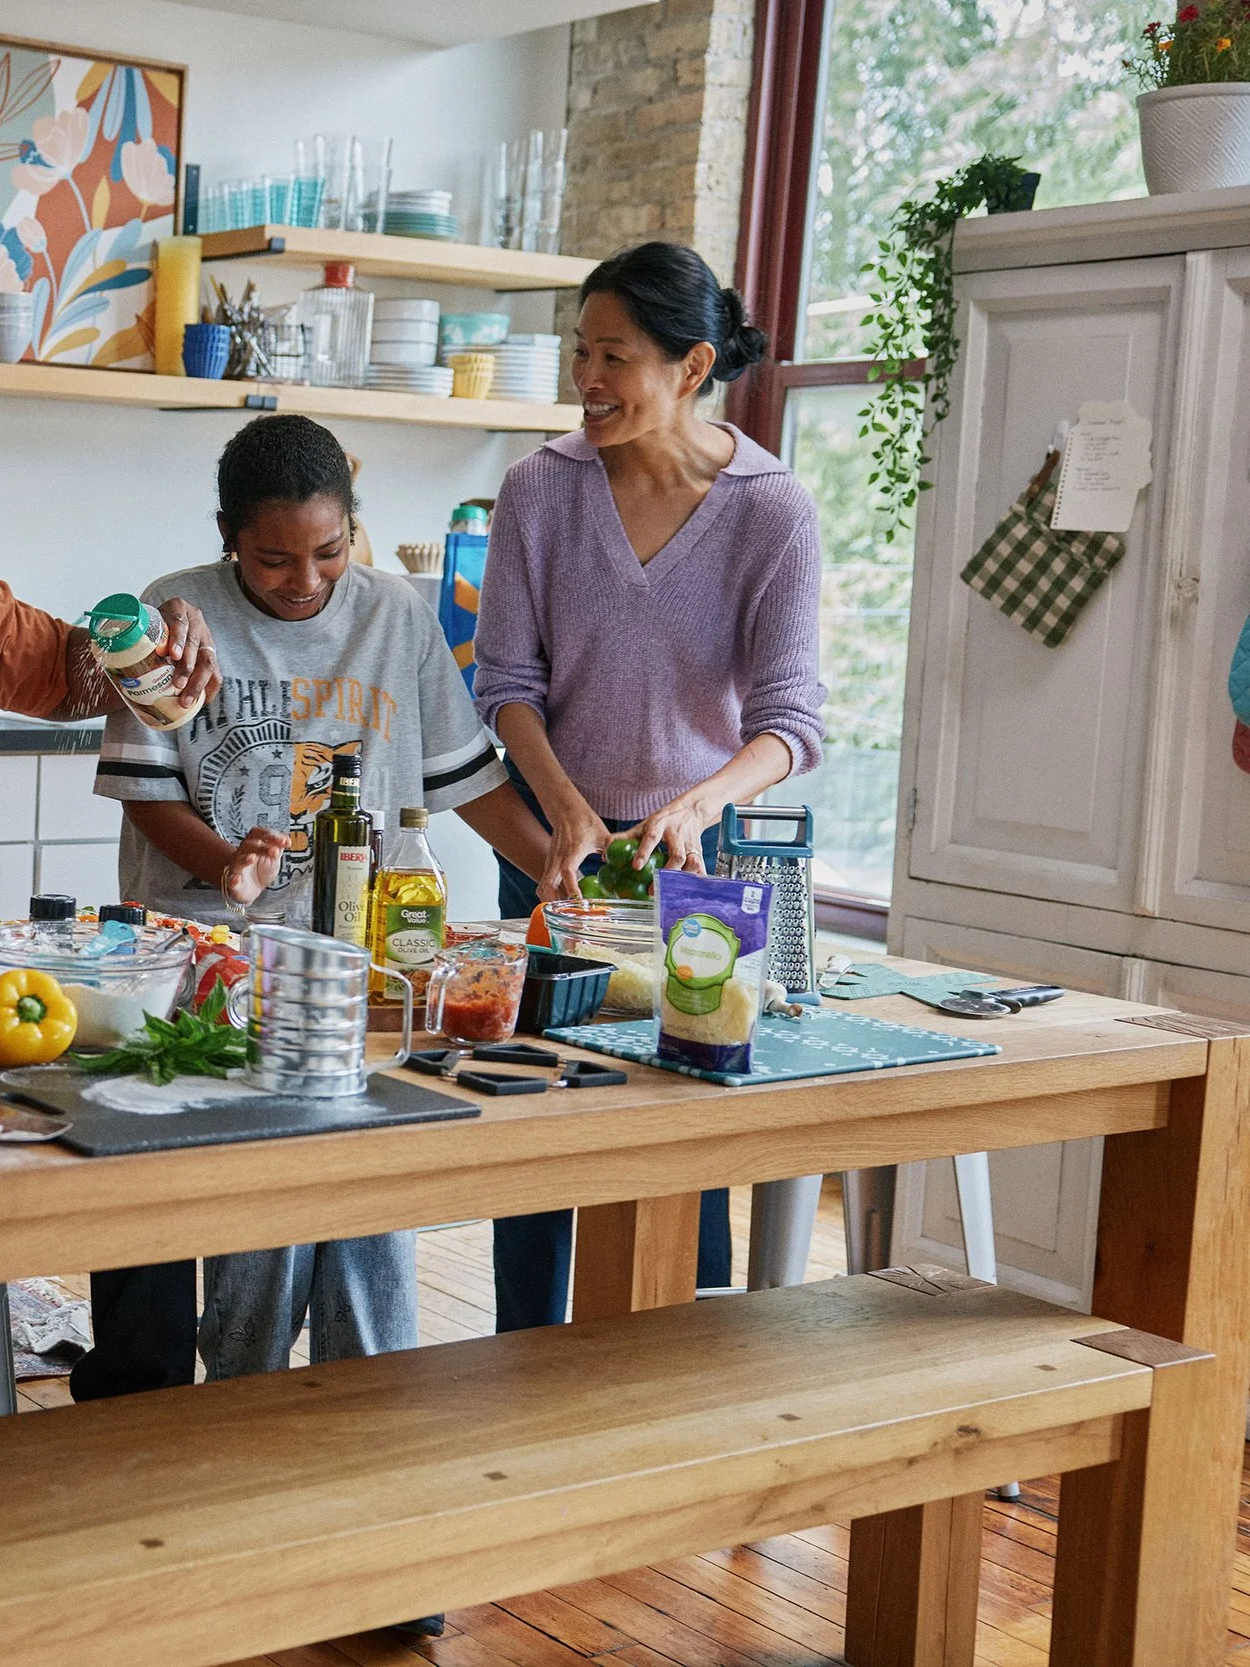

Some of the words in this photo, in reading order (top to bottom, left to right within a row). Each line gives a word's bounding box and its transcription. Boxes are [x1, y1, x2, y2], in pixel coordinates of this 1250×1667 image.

[127, 674, 173, 696] Parmesan
[291, 676, 398, 744] SPIRIT
[339, 776, 360, 787] IBER
[344, 912, 361, 923] Oil
[401, 909, 427, 920] Great
[392, 938, 436, 948] CLASSIC
